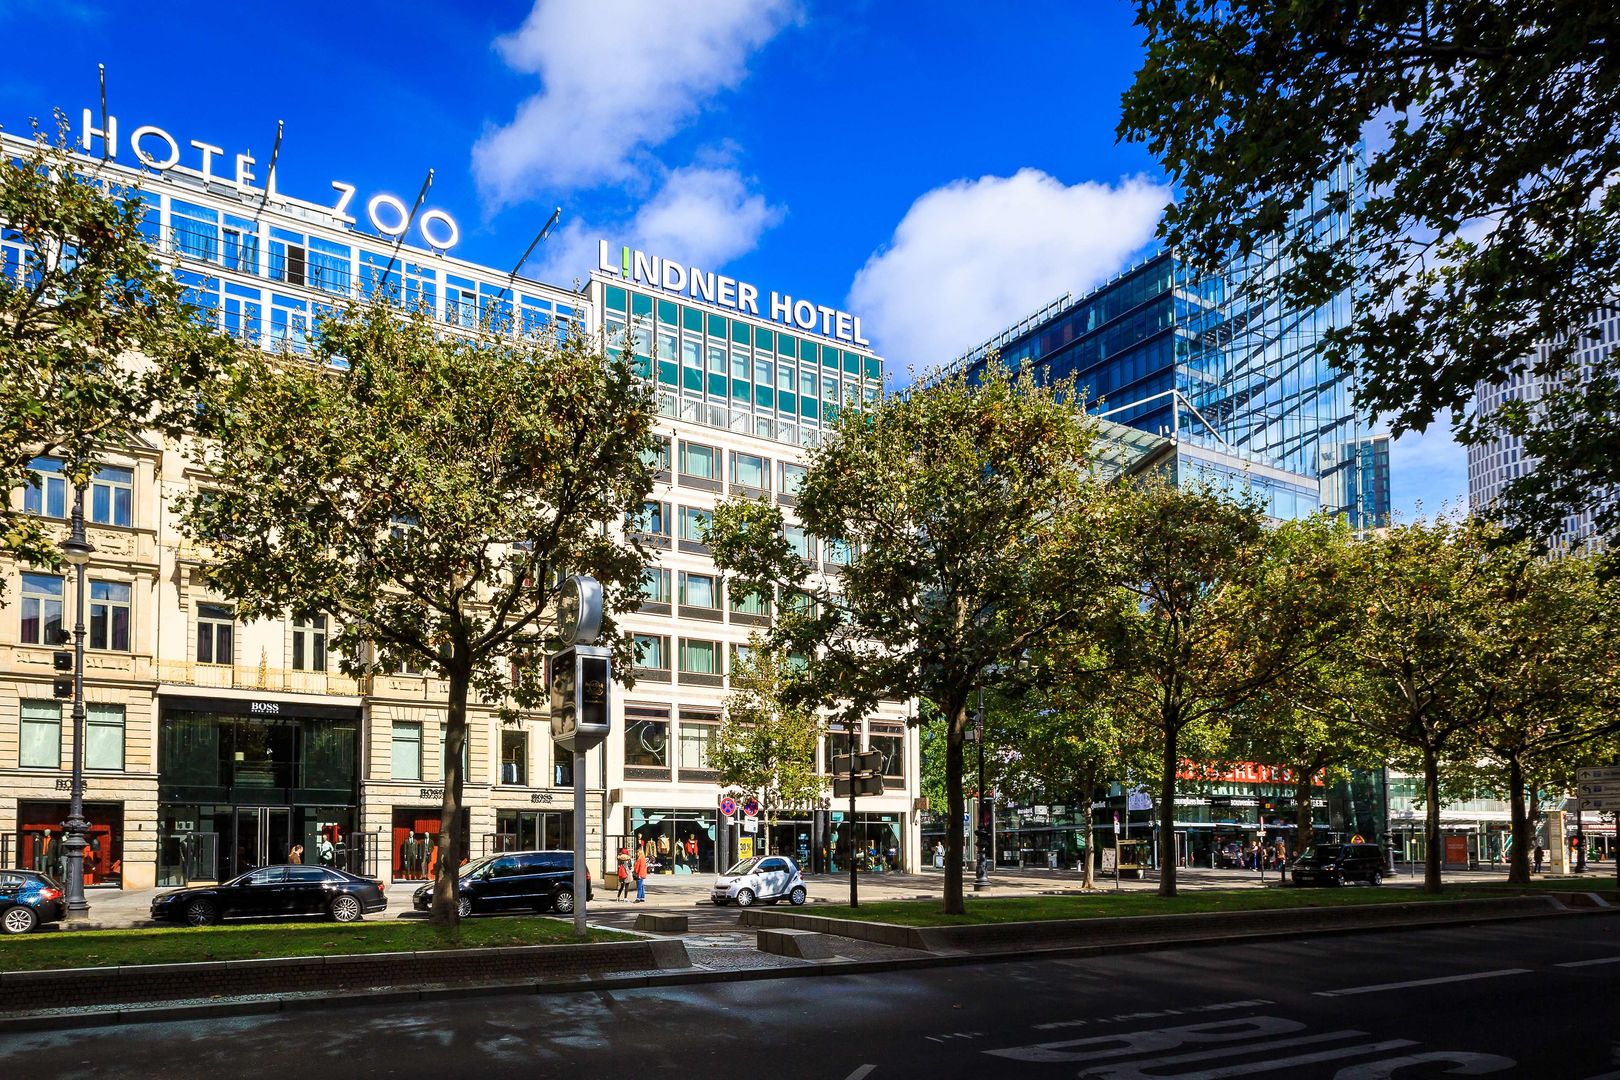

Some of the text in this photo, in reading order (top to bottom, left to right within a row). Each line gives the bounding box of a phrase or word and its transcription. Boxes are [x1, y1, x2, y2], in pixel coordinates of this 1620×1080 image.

[82, 108, 459, 250] HOTEL ZOO
[769, 291, 870, 347] HOTEL
[251, 702, 279, 711] BOSS
